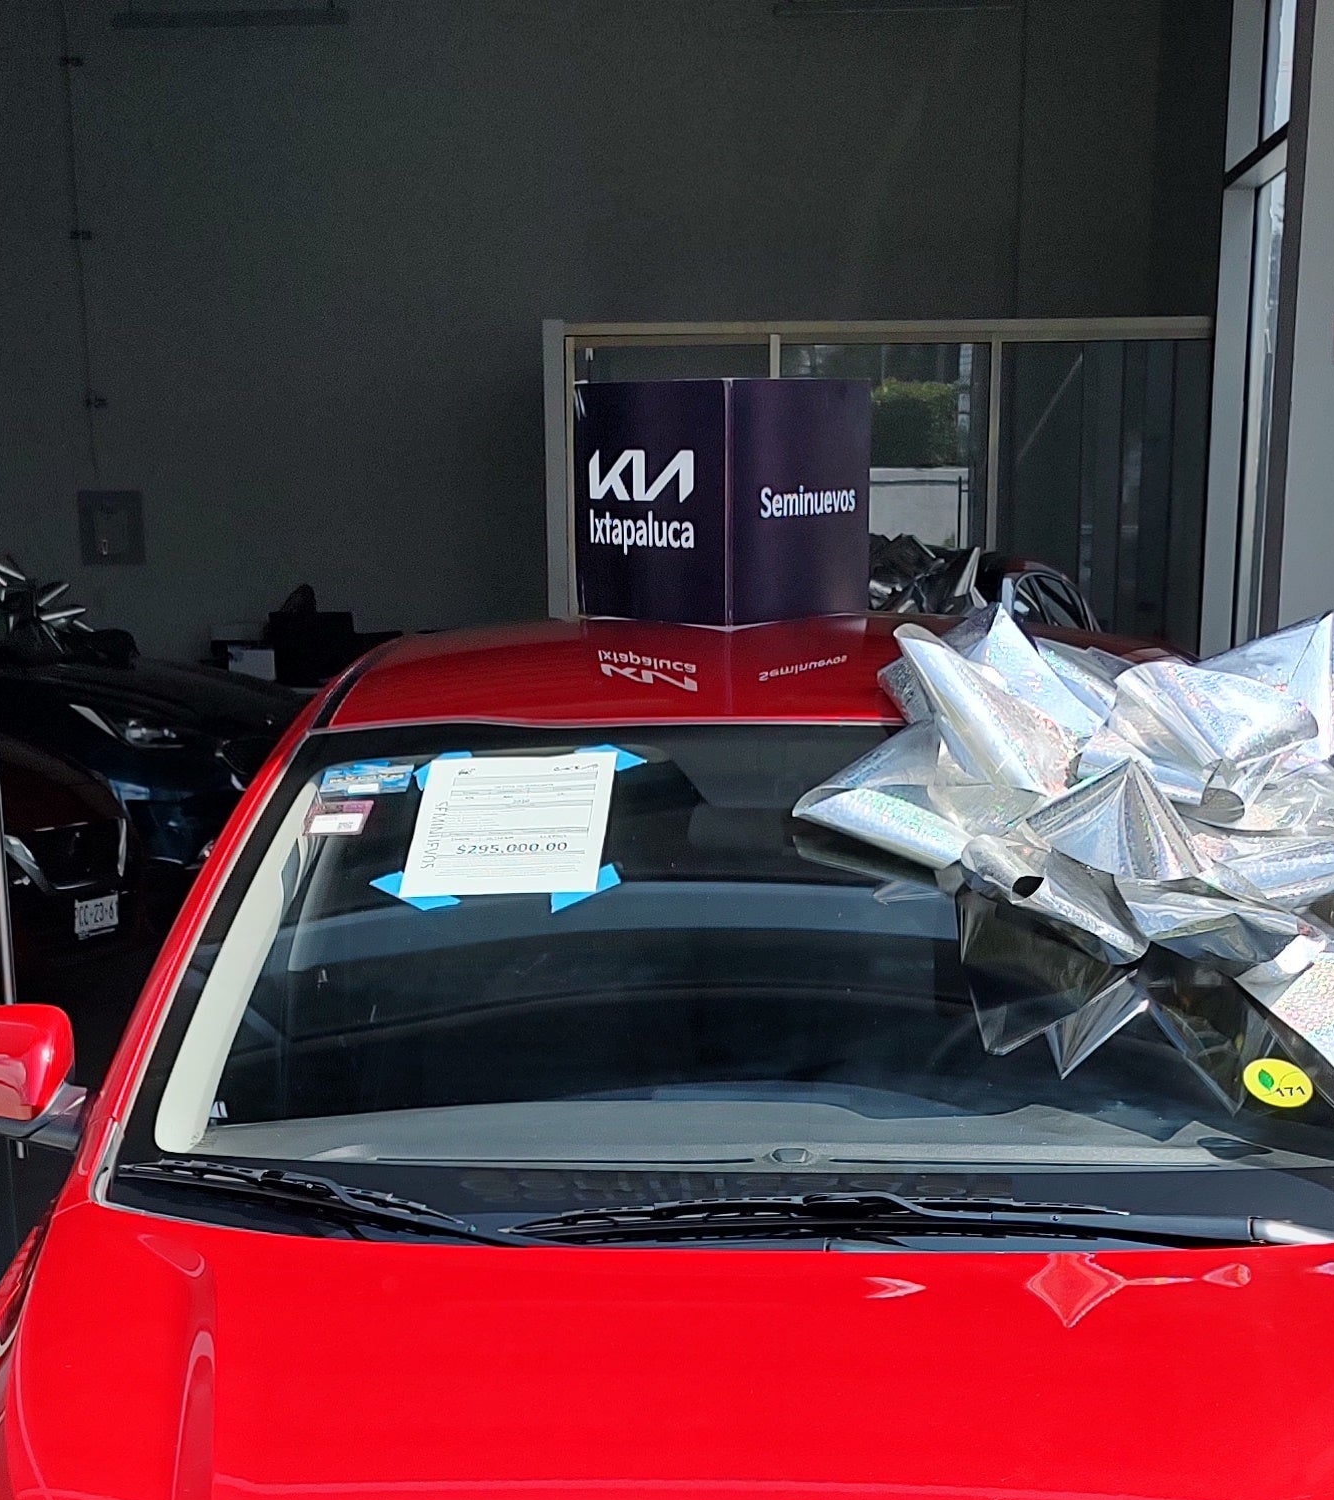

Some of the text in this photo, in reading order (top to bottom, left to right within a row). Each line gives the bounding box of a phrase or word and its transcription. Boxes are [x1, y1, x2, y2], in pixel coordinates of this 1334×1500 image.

[589, 449, 694, 503] KIA
[760, 485, 856, 518] Seminuevos
[590, 509, 694, 555] Ixtapaluca
